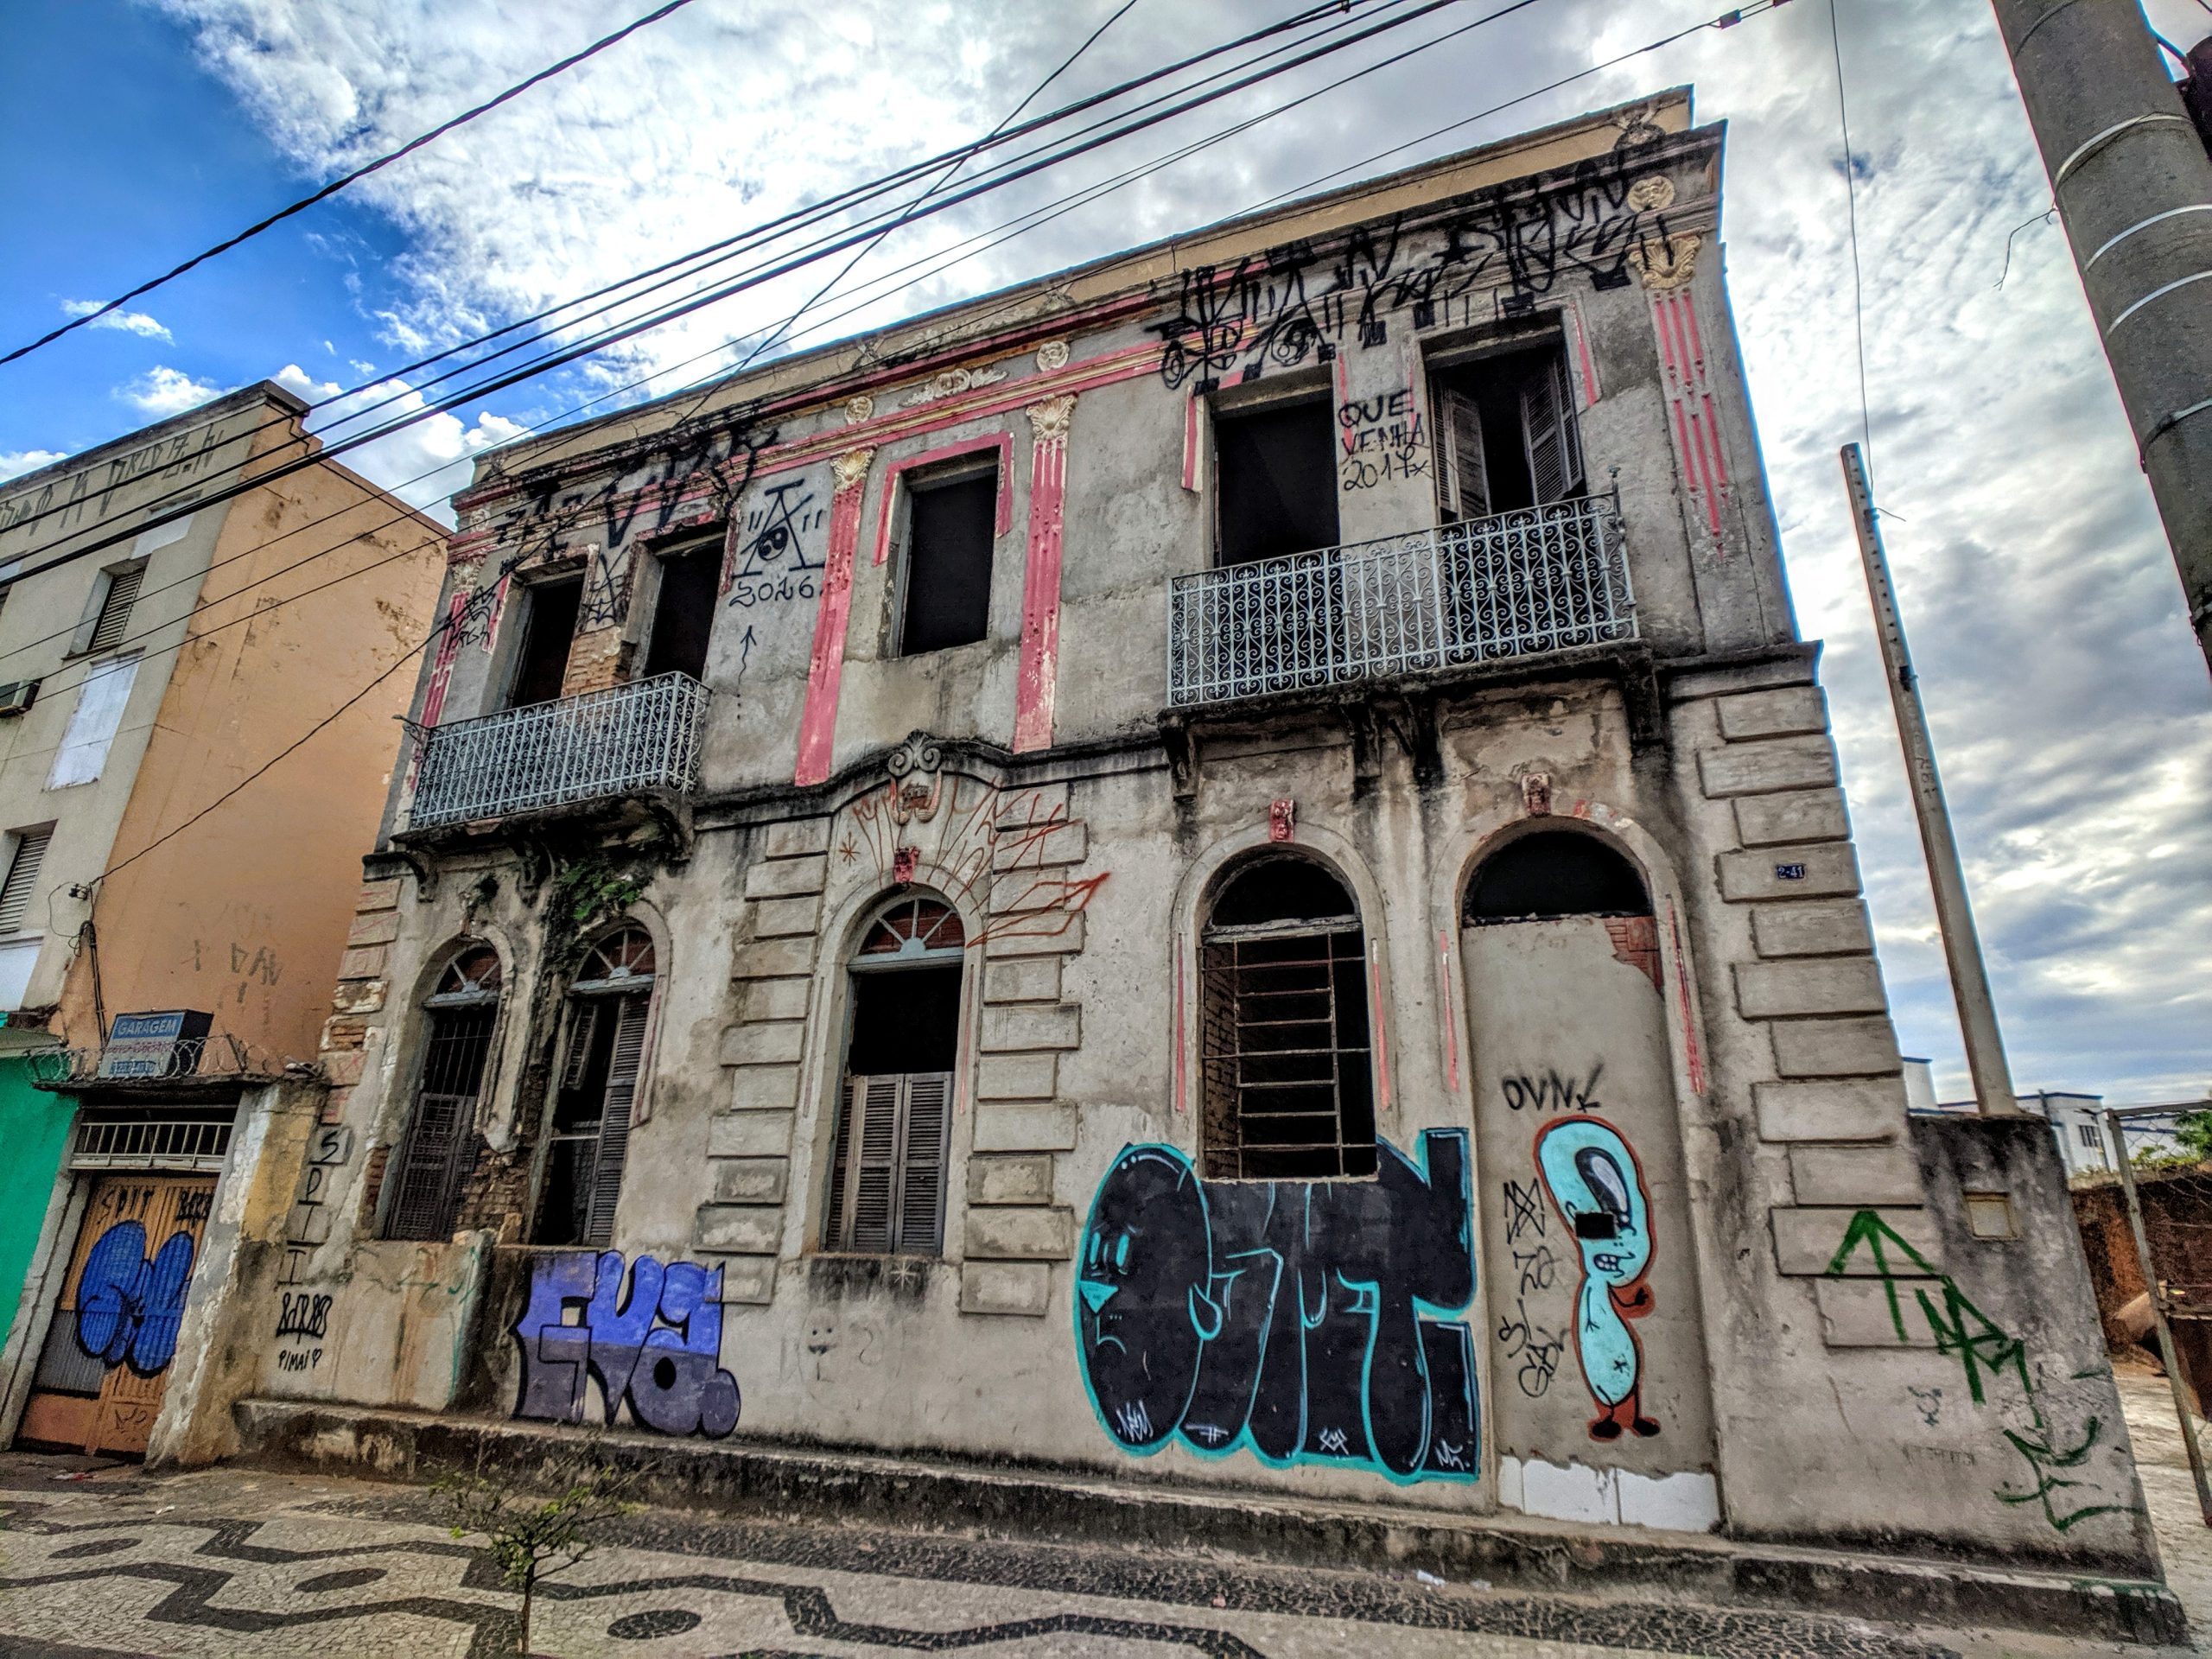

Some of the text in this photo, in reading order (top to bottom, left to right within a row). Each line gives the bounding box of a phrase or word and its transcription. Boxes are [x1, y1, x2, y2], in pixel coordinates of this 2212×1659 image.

[1338, 387, 1414, 429] QUE
[1778, 866, 1803, 879] 2-41
[118, 1018, 177, 1036] GARAGEM
